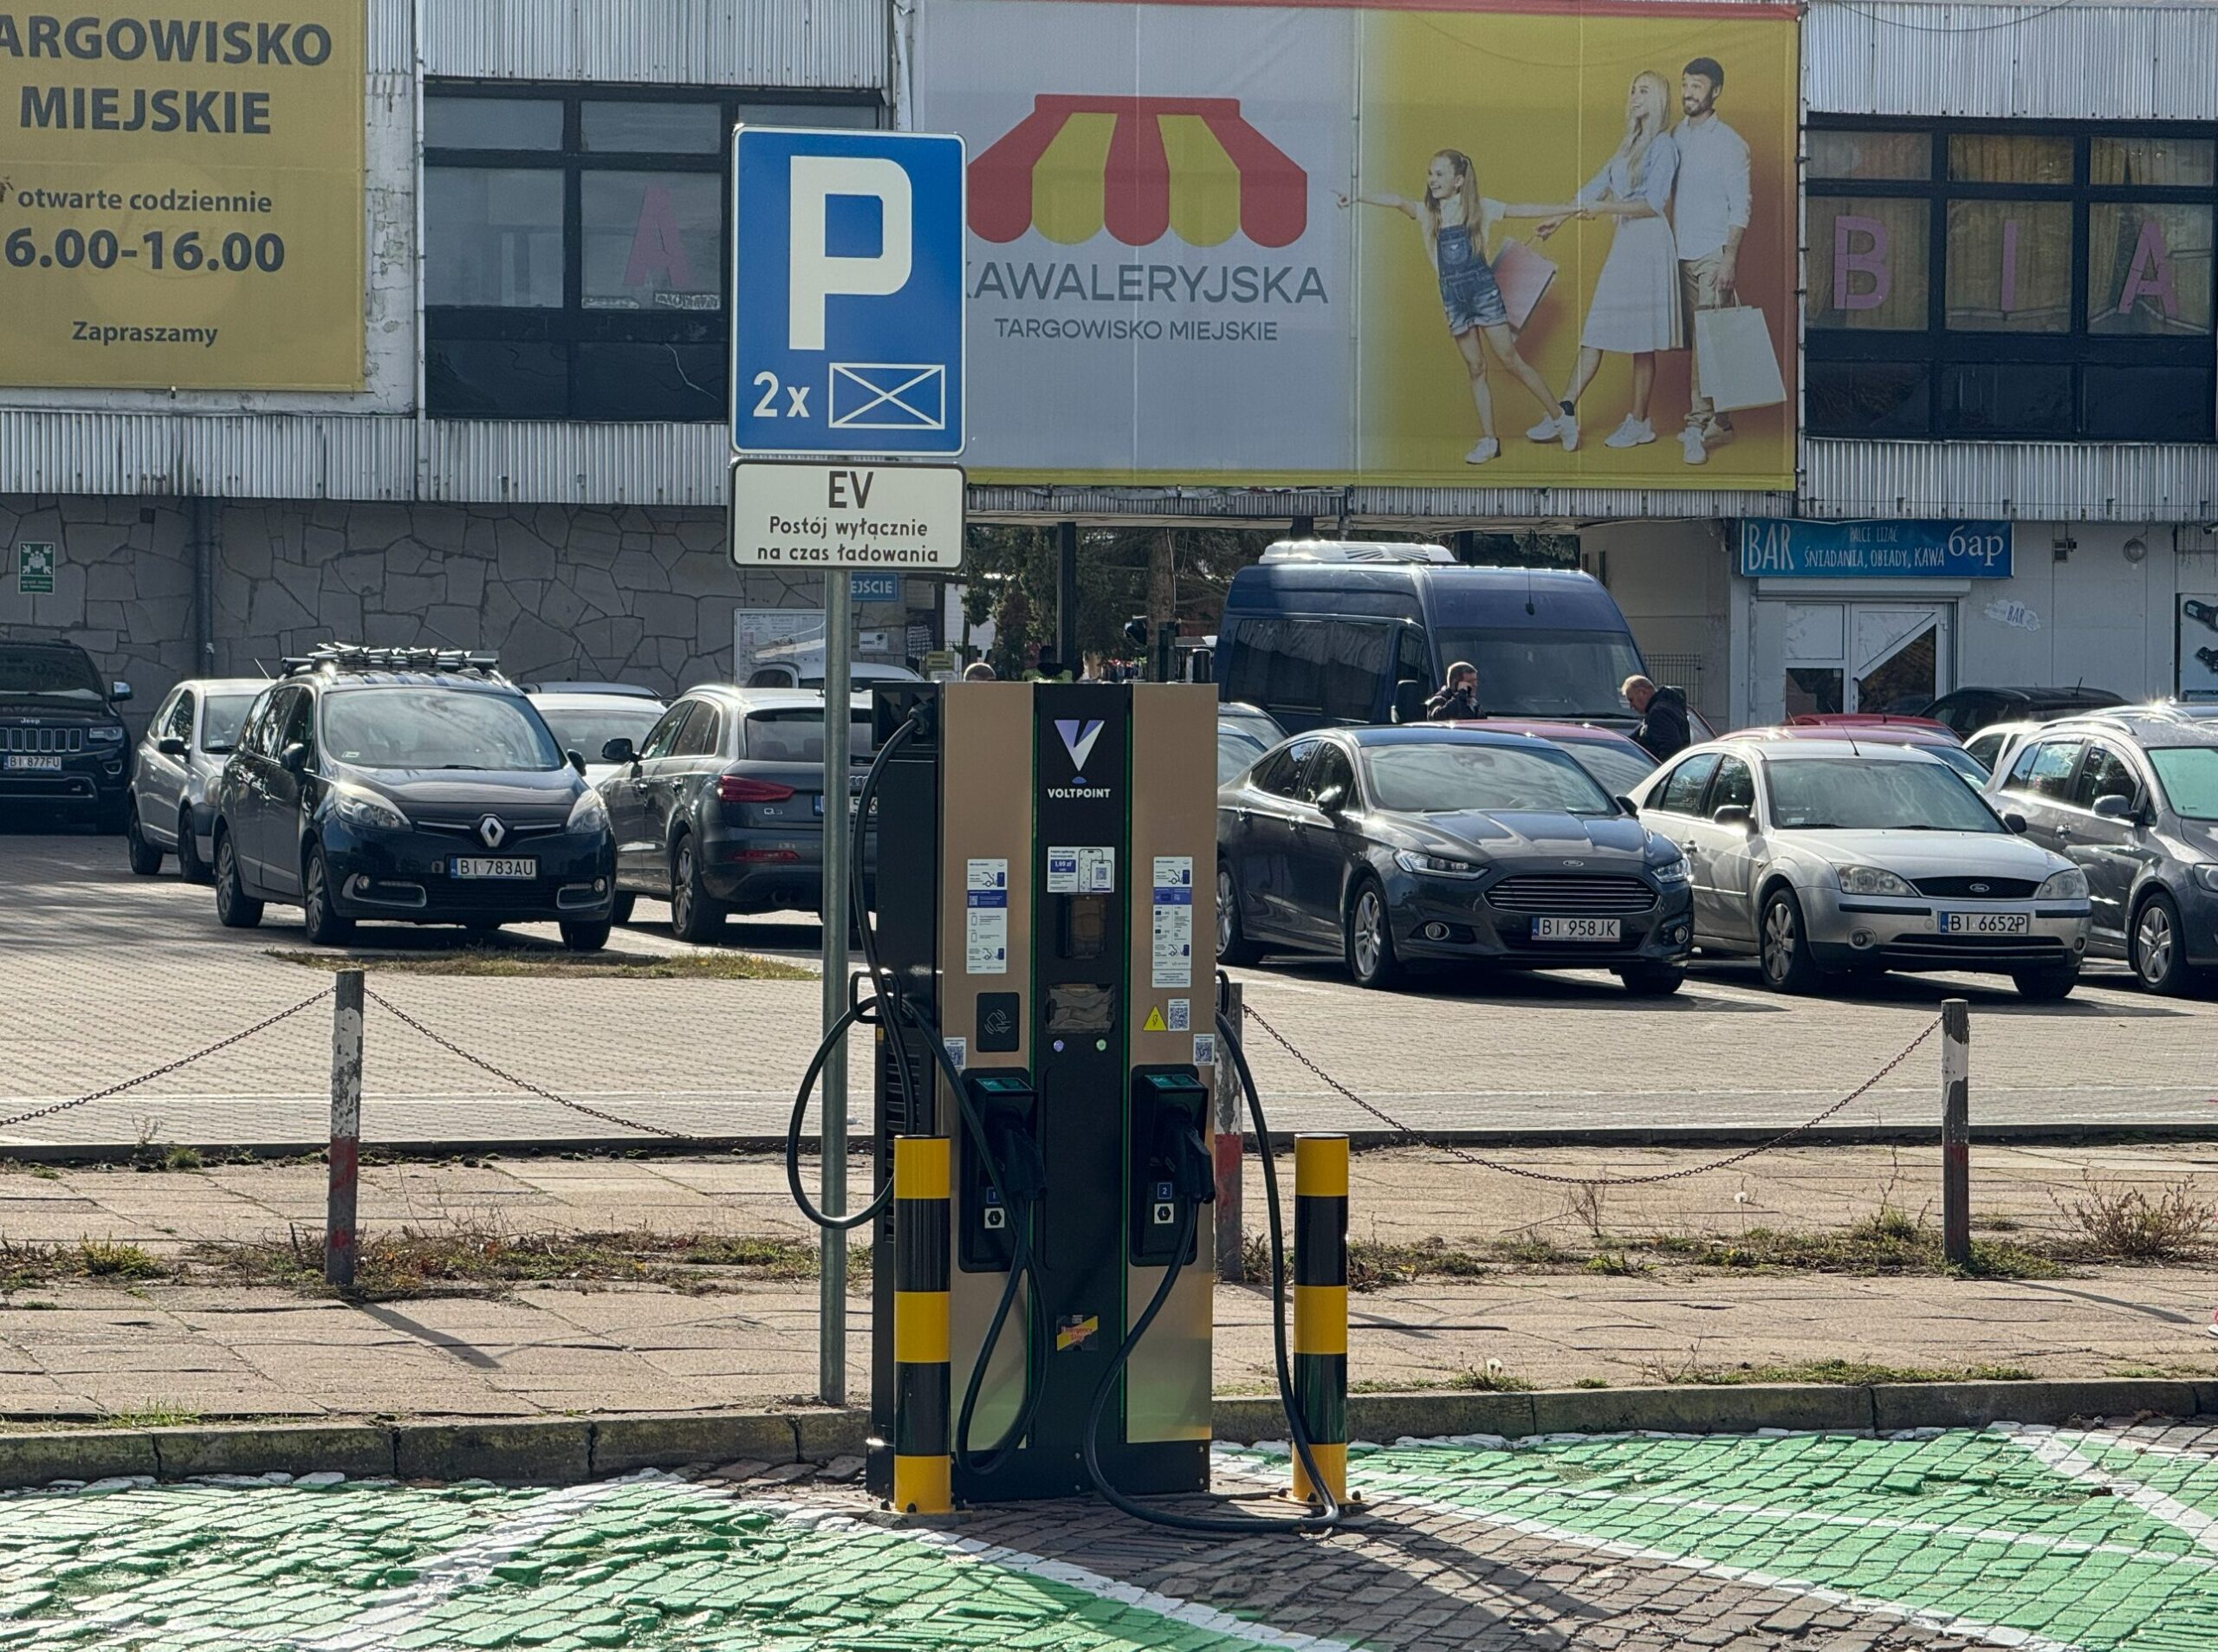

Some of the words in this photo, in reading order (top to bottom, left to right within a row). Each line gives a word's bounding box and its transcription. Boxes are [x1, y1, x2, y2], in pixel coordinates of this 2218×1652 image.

[19, 86, 271, 134] MIEJSKIE
[17, 188, 122, 211] otwarte
[128, 188, 273, 213] codziennie
[621, 181, 691, 288] A
[4, 227, 285, 273] 6.00-16.00
[788, 155, 912, 350] P
[1832, 215, 1890, 310] B
[2118, 218, 2178, 314] A
[966, 261, 1329, 304] AWALERYJSKA
[72, 321, 218, 348] Zapraszamy
[994, 318, 1163, 340] TARGOWISKO
[1170, 321, 1278, 341] MIEJSKIE
[828, 470, 874, 509] EV
[769, 515, 827, 539] Postój
[835, 518, 928, 540] wyłącznie
[757, 547, 781, 560] na
[789, 547, 829, 561] czas
[837, 543, 938, 563] ładowania
[1748, 522, 1794, 571] BAR
[1914, 547, 1945, 567] KAWA
[1948, 524, 2004, 567] бар
[850, 578, 893, 594] EJŚCIE
[2007, 605, 2025, 624] BAR
[10, 756, 22, 767] BI
[1047, 787, 1111, 799] VOLTPOINT
[460, 859, 477, 874] BI
[485, 860, 533, 876] 783AU
[1541, 919, 1560, 936] BI
[1568, 920, 1616, 936] 958JK
[1950, 915, 1969, 931] BI
[1978, 916, 2026, 932] 6652P
